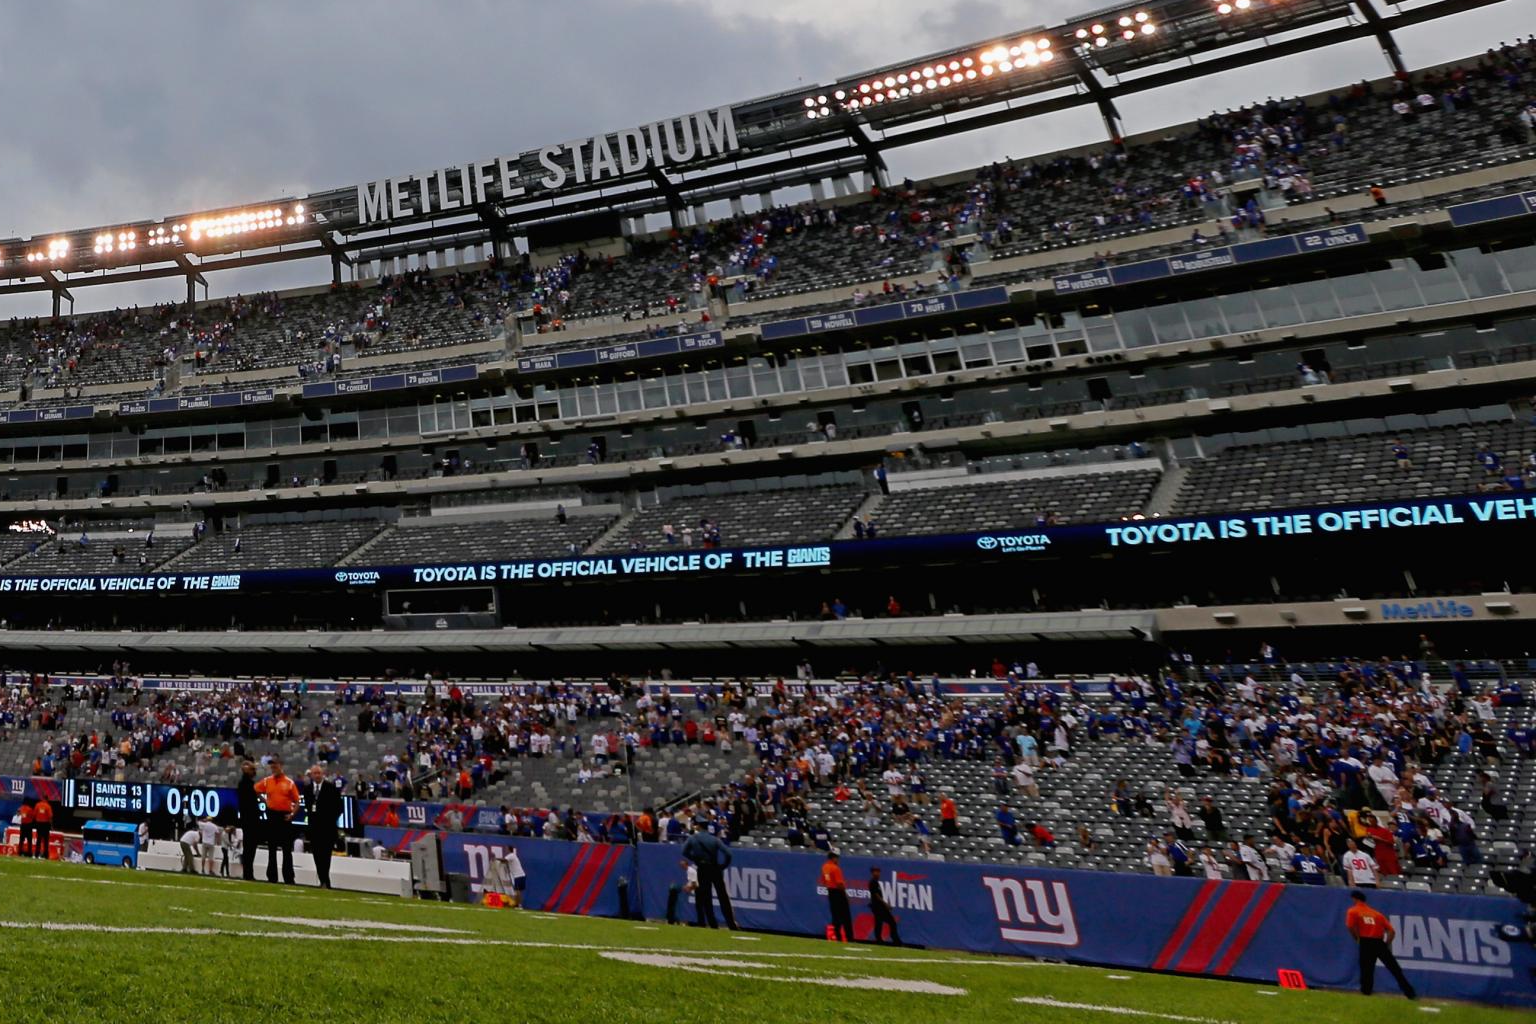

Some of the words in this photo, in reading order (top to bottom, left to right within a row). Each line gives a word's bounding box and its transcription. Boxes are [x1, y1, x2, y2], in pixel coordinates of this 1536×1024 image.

[357, 153, 525, 224] METLIFE
[538, 105, 740, 189] STADIUM
[1325, 232, 1359, 247] LYNCH
[1070, 276, 1110, 291] WEBSTER
[925, 302, 946, 314] HUFF
[697, 337, 717, 348] TISCH
[609, 349, 636, 360] GIFFORD
[1105, 521, 1215, 546] TOYOTA
[1219, 519, 1248, 539] IS
[1252, 514, 1313, 536] THE
[1317, 503, 1464, 532] OFFICIAL
[997, 534, 1052, 547] TOYOTA
[414, 566, 477, 582] TOYOTA
[480, 565, 497, 580] IS
[500, 564, 534, 579] THE
[537, 560, 617, 578] OFFICIAL
[621, 554, 701, 574] VEHICLE
[704, 552, 733, 570] OF
[743, 550, 783, 568] THE
[787, 547, 831, 564] GIANTS
[0, 578, 12, 591] IS
[14, 578, 38, 591] THE
[40, 578, 96, 592] OFFICIAL
[100, 577, 154, 591] VEHICLE
[157, 577, 176, 590] OF
[183, 576, 209, 590] THE
[211, 574, 241, 588] GIANTS
[347, 571, 380, 581] TOYOTA
[1380, 600, 1474, 620] MetLife
[11, 779, 25, 795] ny
[96, 784, 127, 795] SAINTS
[131, 785, 142, 796] 13
[96, 797, 127, 809] GIANTS
[131, 799, 142, 810] 16
[167, 787, 220, 818] 0:00
[406, 805, 426, 824] ny
[1351, 858, 1368, 871] 90
[713, 867, 777, 902] ANTS
[879, 870, 933, 912] WFAN
[983, 876, 1080, 946] ny
[1389, 914, 1512, 966] IANTS
